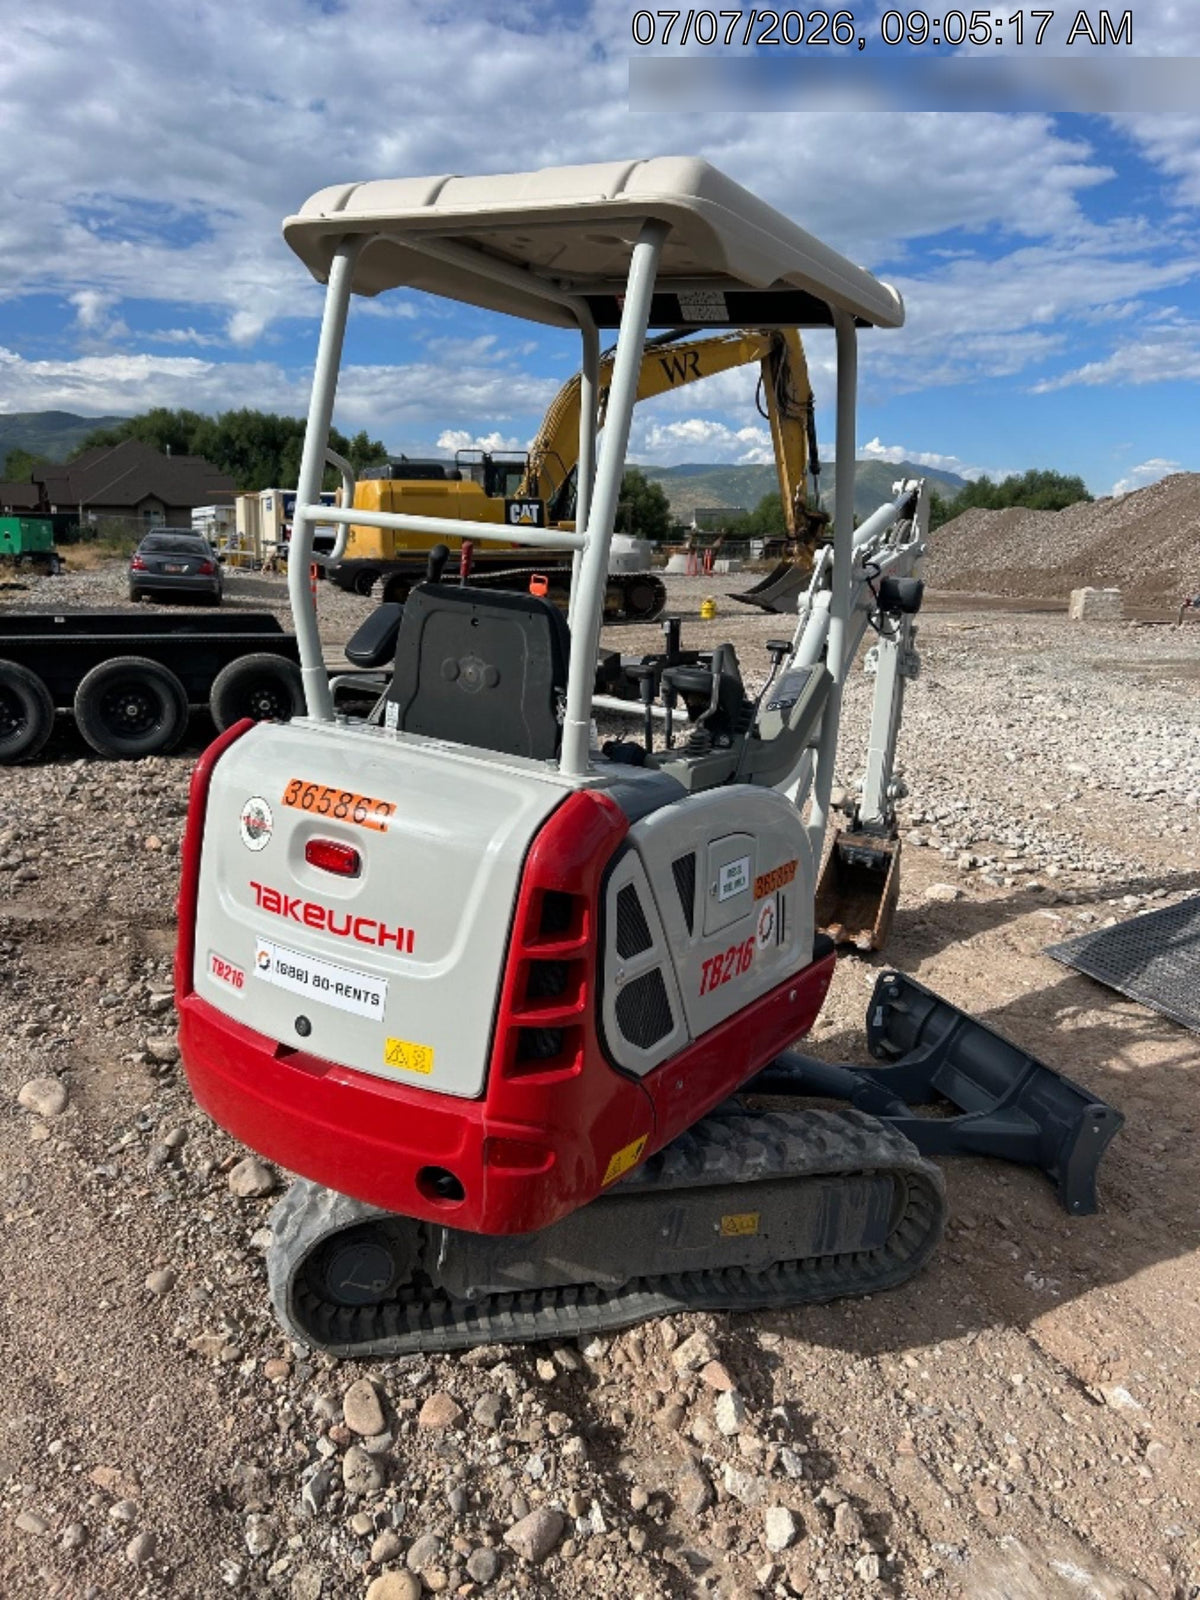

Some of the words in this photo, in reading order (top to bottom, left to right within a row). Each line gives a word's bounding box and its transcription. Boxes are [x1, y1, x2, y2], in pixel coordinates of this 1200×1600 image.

[659, 351, 703, 385] WR
[509, 503, 540, 524] CAT
[212, 956, 244, 989] TB216
[698, 935, 757, 997] TB216
[312, 975, 380, 1006] 80-RENTS
